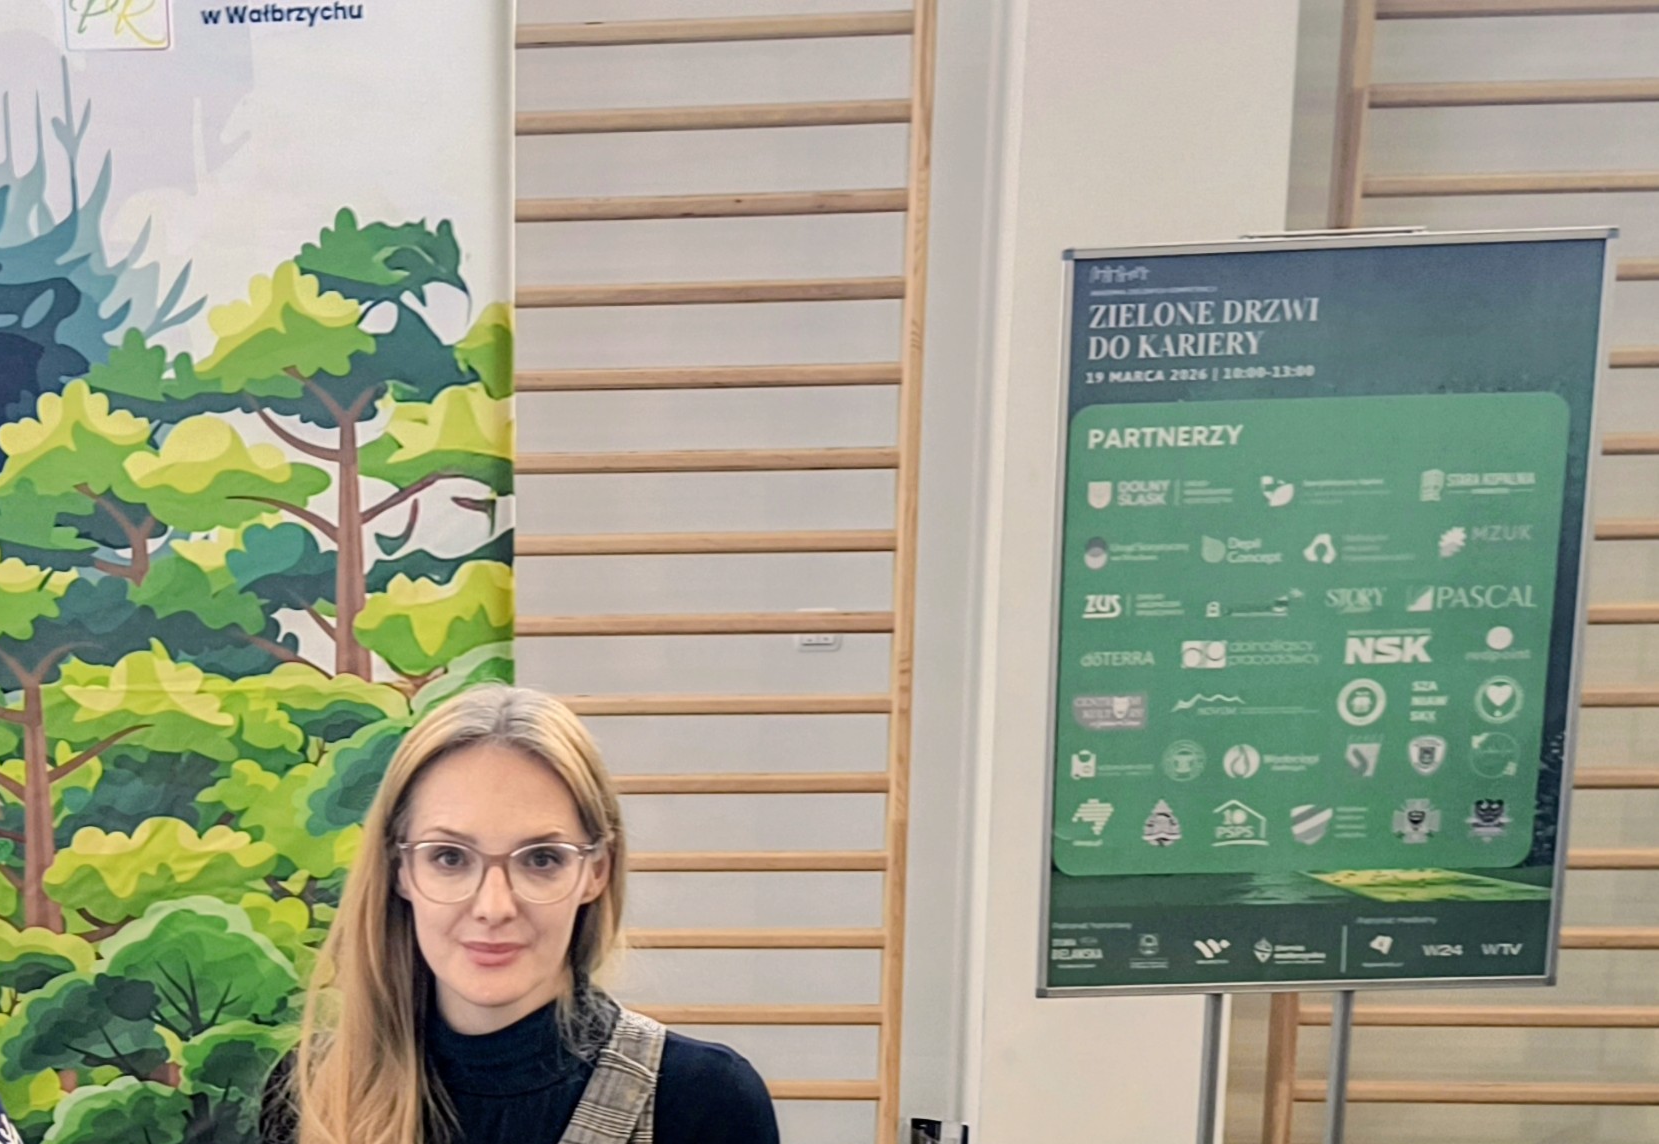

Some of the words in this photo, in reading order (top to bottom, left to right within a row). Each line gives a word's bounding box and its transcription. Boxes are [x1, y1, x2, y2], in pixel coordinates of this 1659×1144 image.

[201, 10, 221, 25] w
[226, 1, 364, 27] Wałbrzychu
[1089, 301, 1215, 329] ZIELONE
[1222, 297, 1320, 324] DRZWI
[1088, 335, 1131, 360] DO
[1138, 331, 1265, 358] KARIERY
[1085, 372, 1105, 384] 19
[1109, 370, 1165, 382] MARCA
[1170, 368, 1208, 381] 2026
[1088, 425, 1244, 449] PARTNERZY
[1118, 480, 1170, 492] DOLNY
[1472, 525, 1534, 541] MZUK
[1082, 594, 1122, 619] ZUS
[1436, 584, 1538, 609] PASCAL
[1344, 635, 1432, 665] NSK
[1215, 825, 1254, 839] PSPS
[1422, 944, 1464, 957] W24
[1481, 943, 1524, 956] WTV
